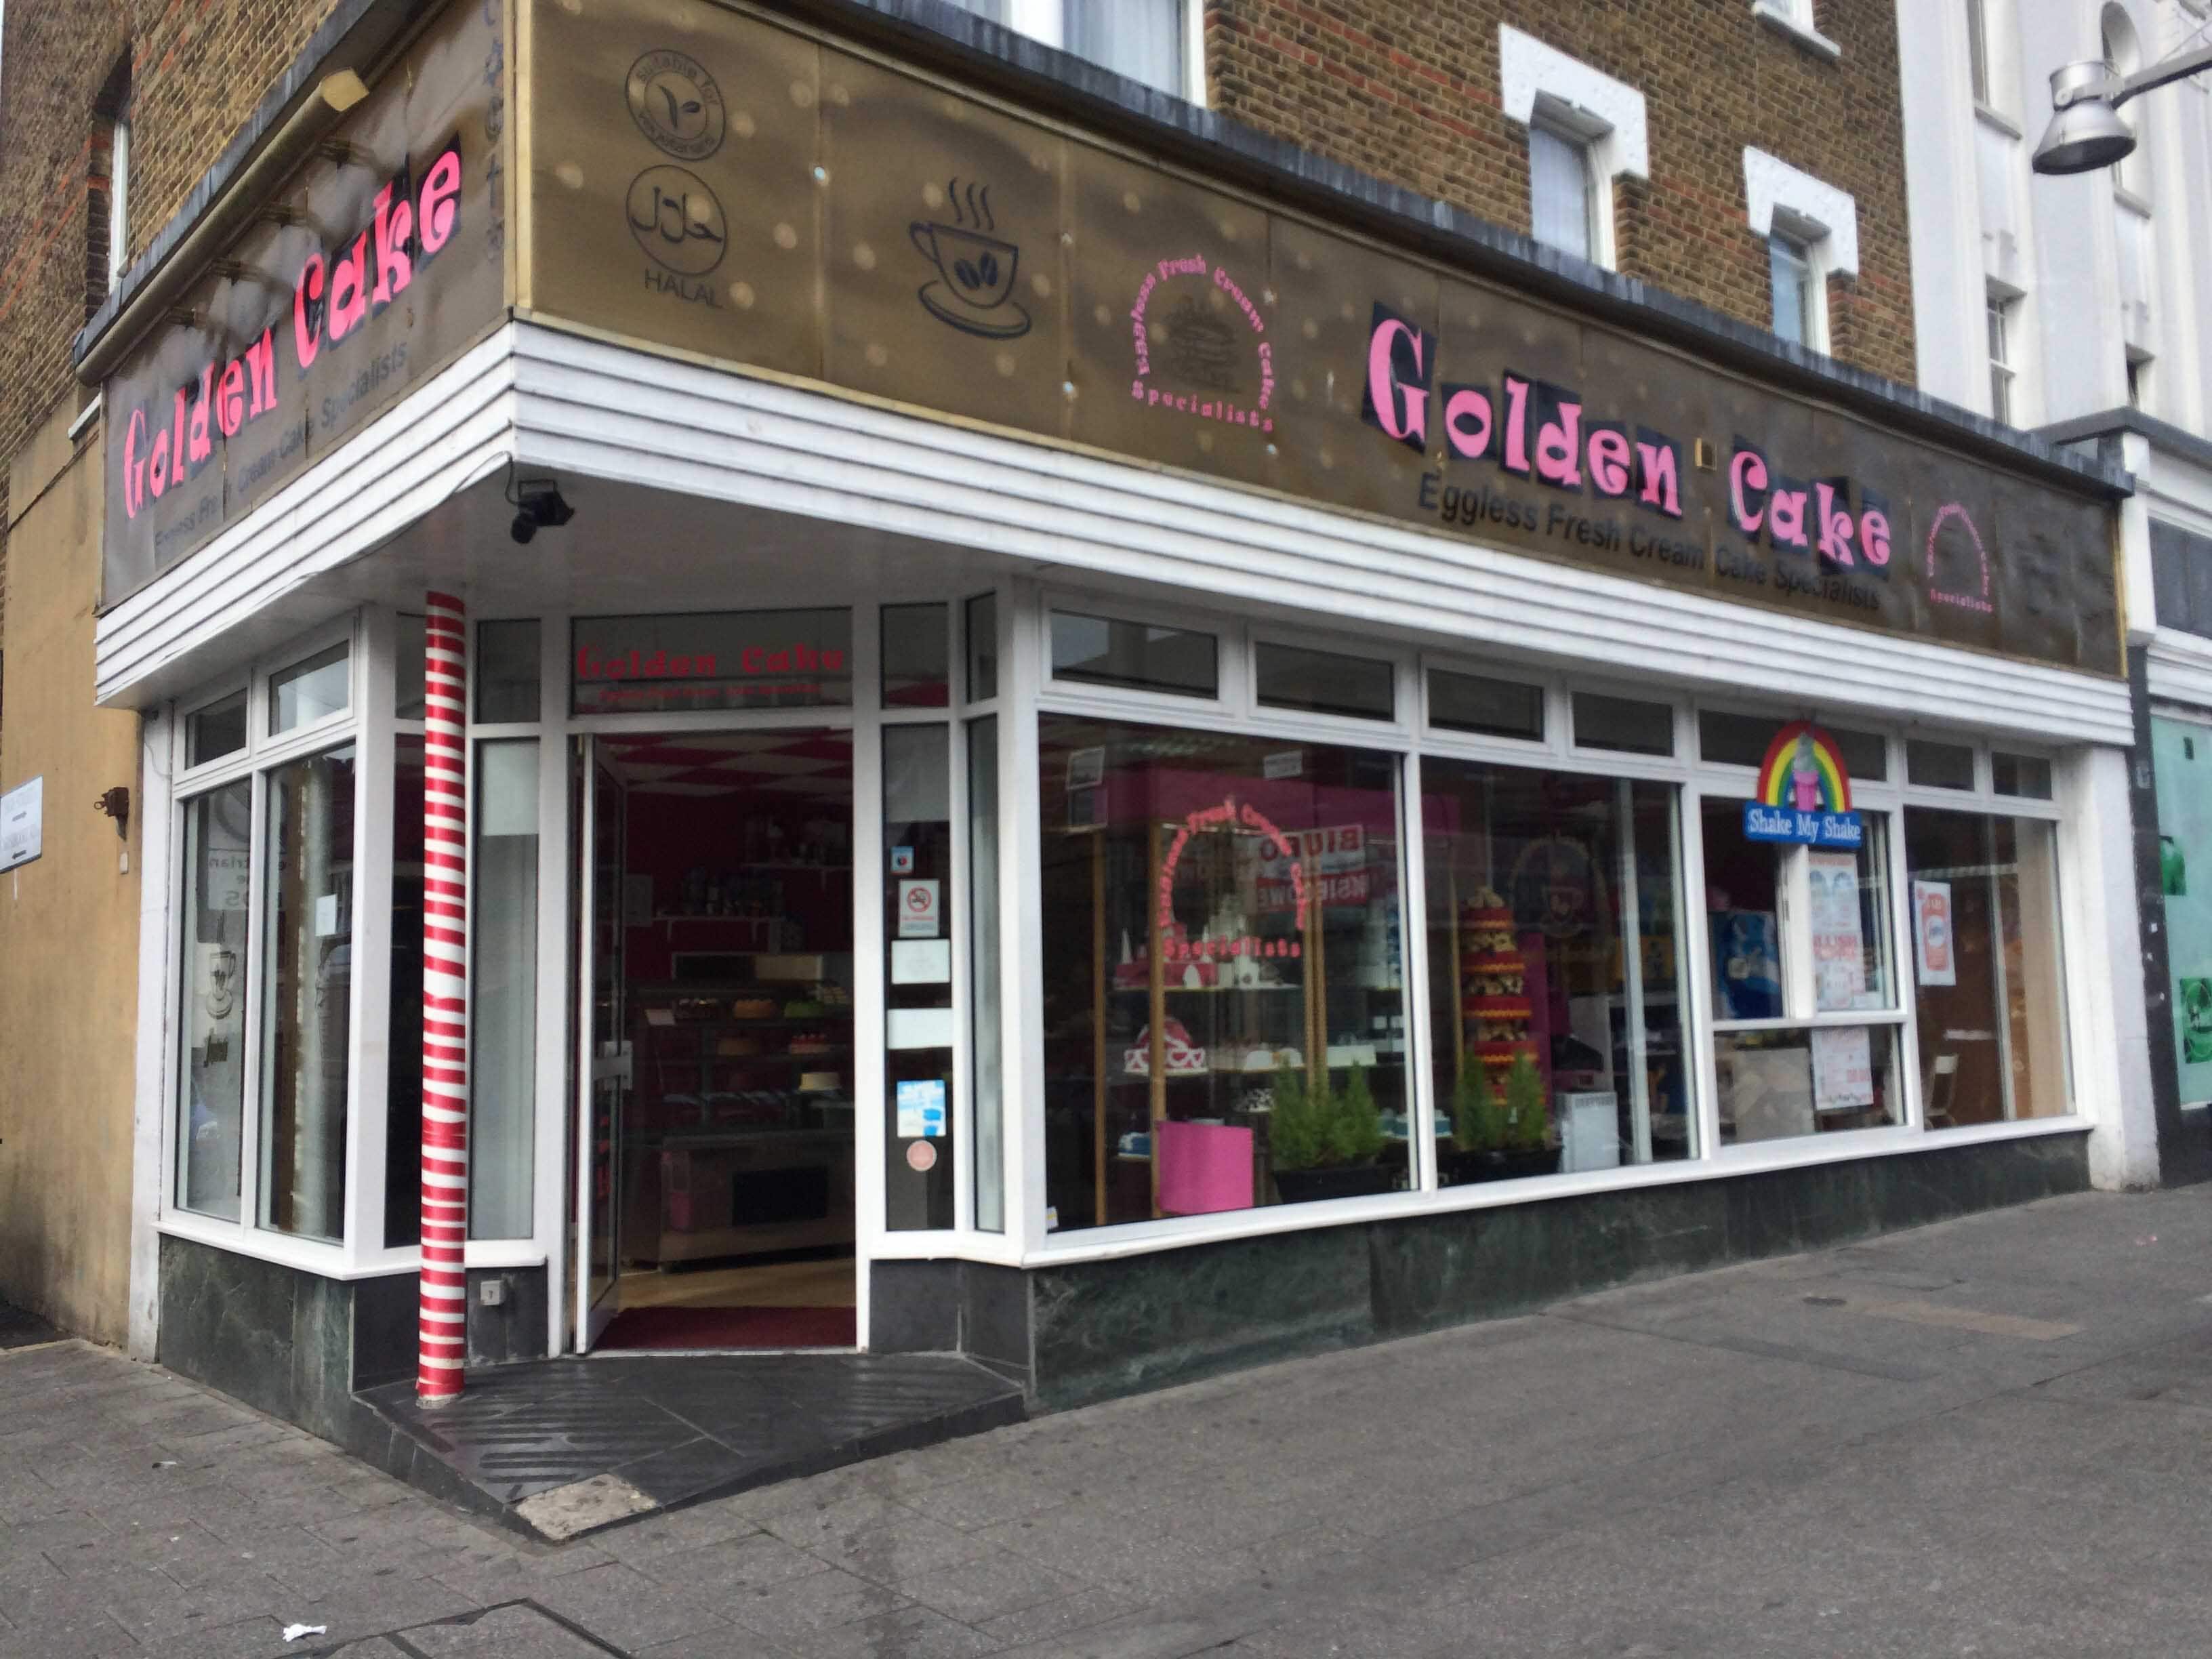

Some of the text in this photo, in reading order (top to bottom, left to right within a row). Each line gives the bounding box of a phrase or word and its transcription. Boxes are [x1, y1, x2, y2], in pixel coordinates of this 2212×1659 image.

[630, 186, 723, 243] حلال
[644, 267, 724, 308] HALAL
[1158, 253, 1207, 281] Fresh
[123, 149, 462, 518] Golden Cake
[1132, 380, 1273, 432] Specialists
[1368, 319, 1683, 517] Golden
[1729, 451, 1891, 567] Cake
[1418, 471, 1881, 609] Eggless Fresh Cream Cake Specialists
[577, 643, 844, 679] Golden Cake
[1748, 808, 1862, 843] Shake My Shake
[1162, 935, 1301, 958] Specialists
